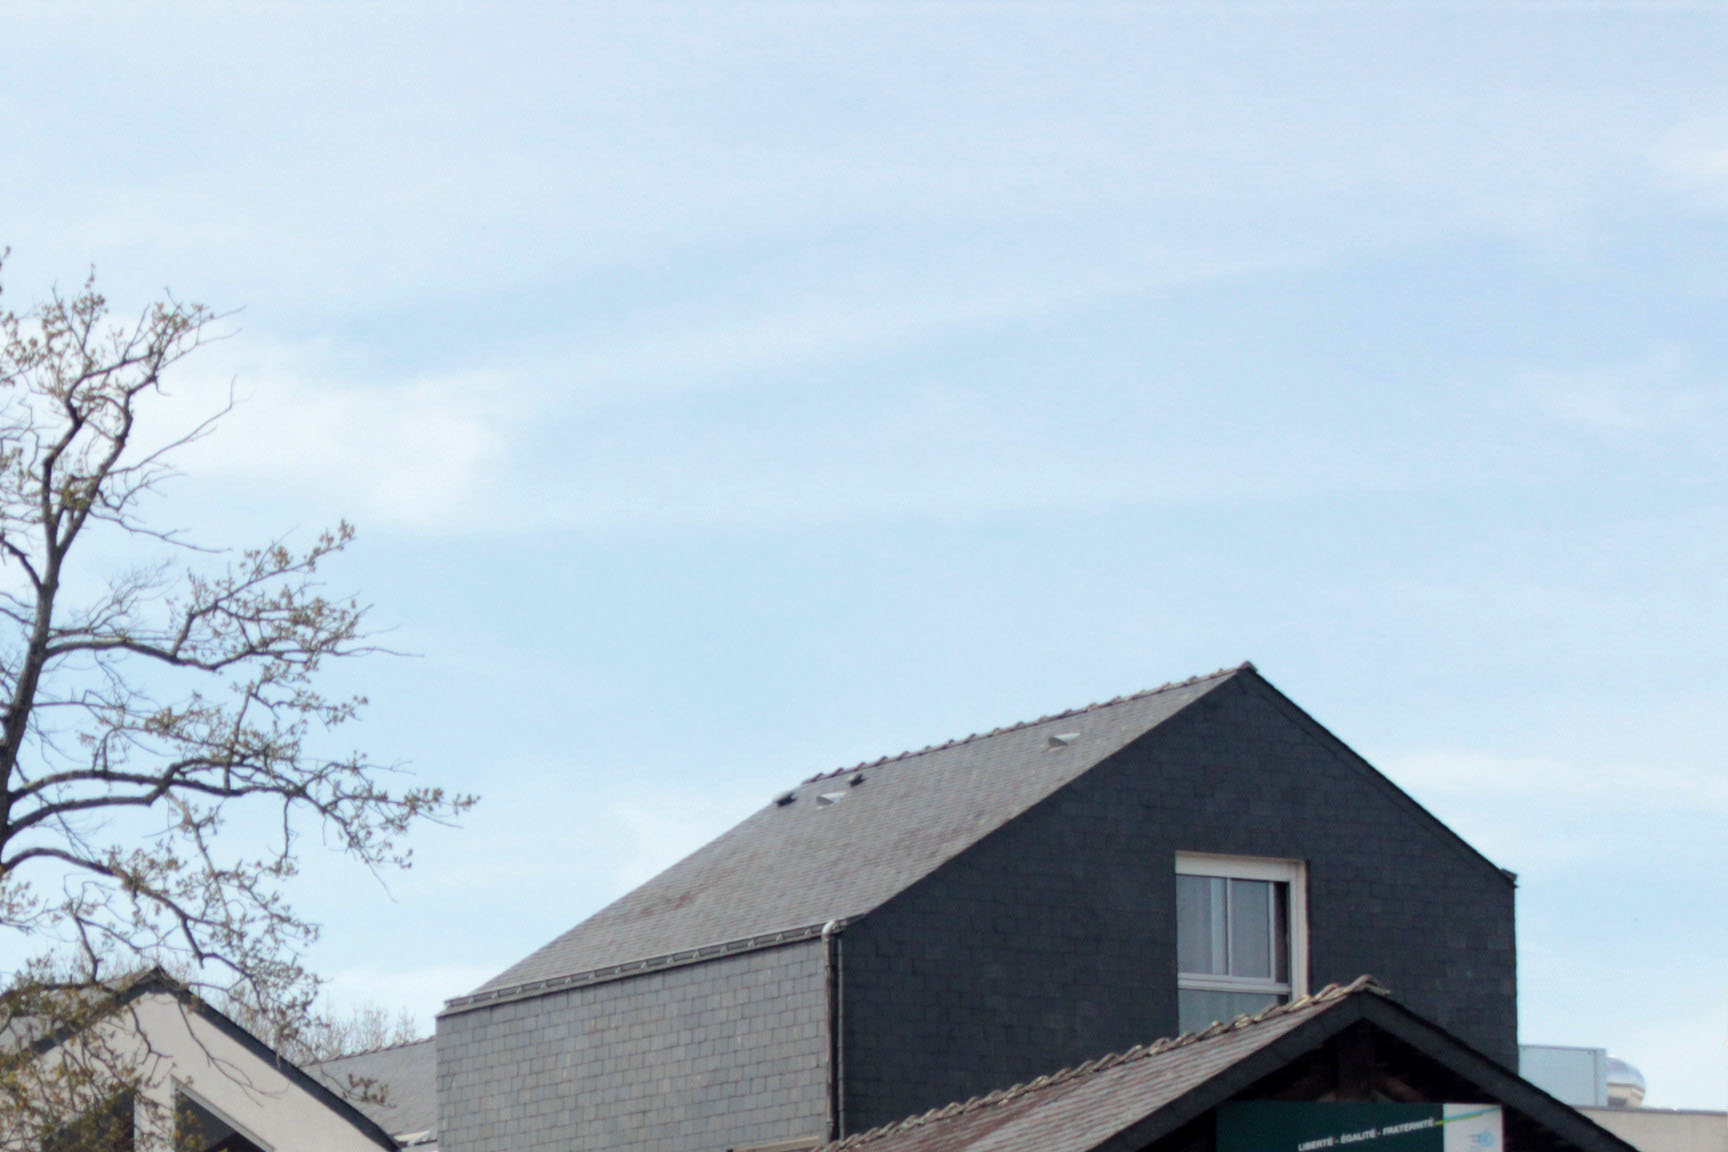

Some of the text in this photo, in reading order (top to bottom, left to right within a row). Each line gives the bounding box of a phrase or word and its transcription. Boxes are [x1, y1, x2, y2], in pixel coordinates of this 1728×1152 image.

[1297, 1136, 1334, 1152] LIBERTÉ
[1340, 1128, 1376, 1144] ÉGALITÉ
[1382, 1117, 1435, 1136] FRATERNITÉ
